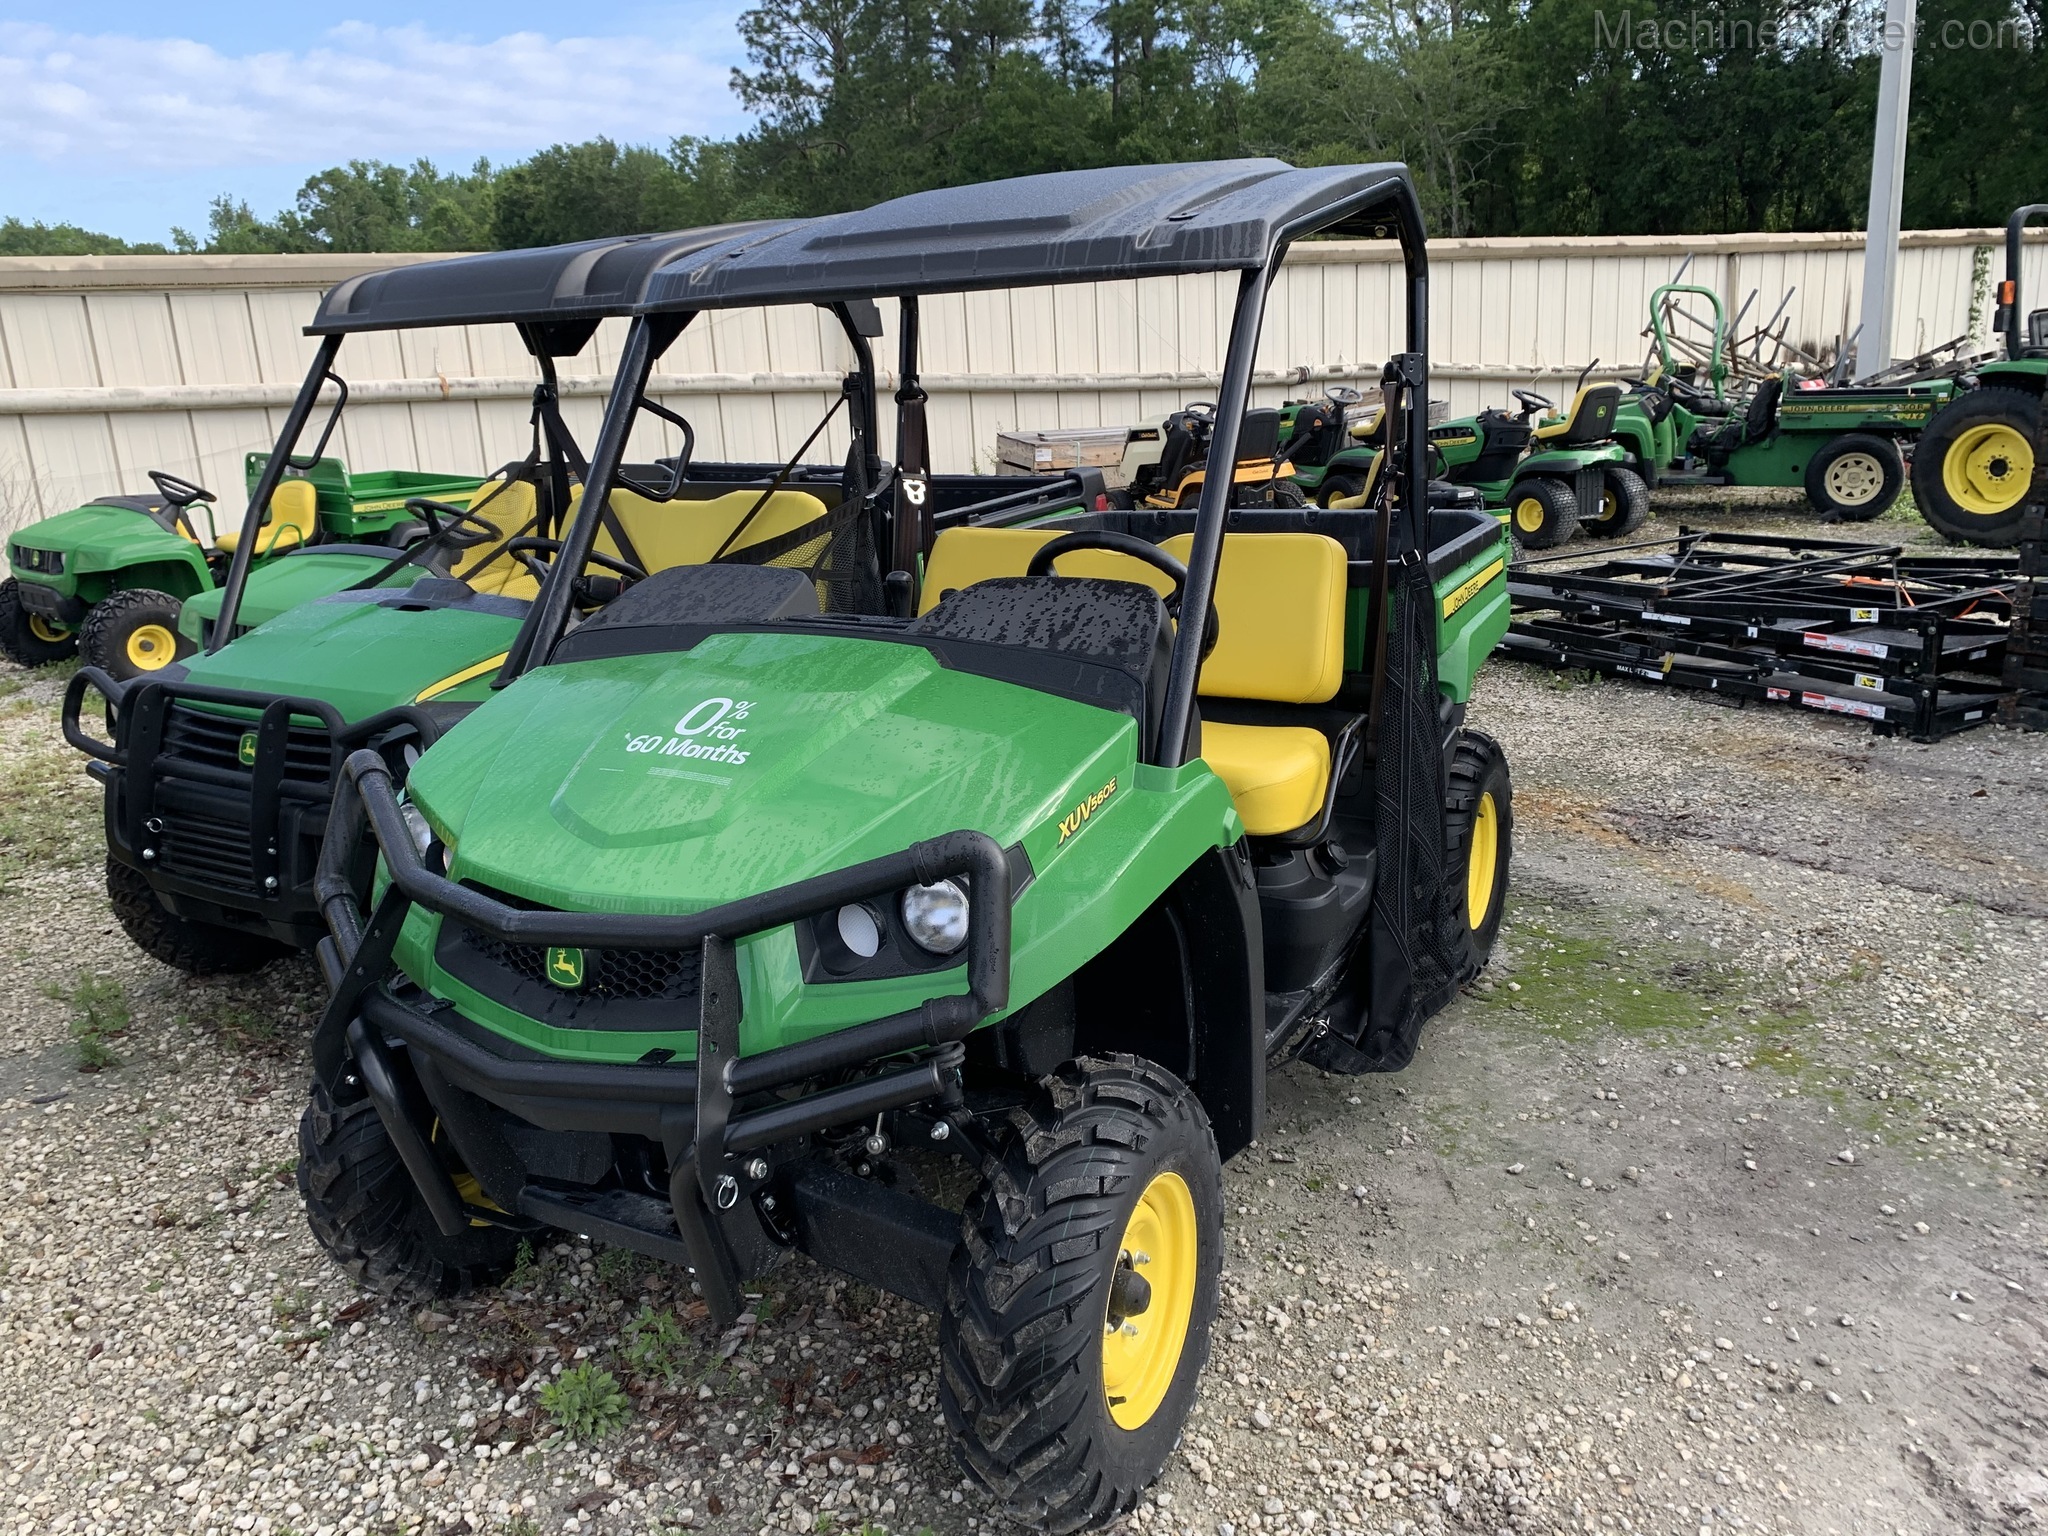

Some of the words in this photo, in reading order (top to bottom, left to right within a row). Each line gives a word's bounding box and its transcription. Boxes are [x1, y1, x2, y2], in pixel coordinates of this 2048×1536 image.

[1464, 579, 1480, 601] DEERE
[1616, 664, 1629, 672] MAX
[706, 721, 747, 741] for
[626, 735, 663, 753] 60
[657, 737, 751, 765] Months
[1058, 775, 1117, 847] XUV560E
